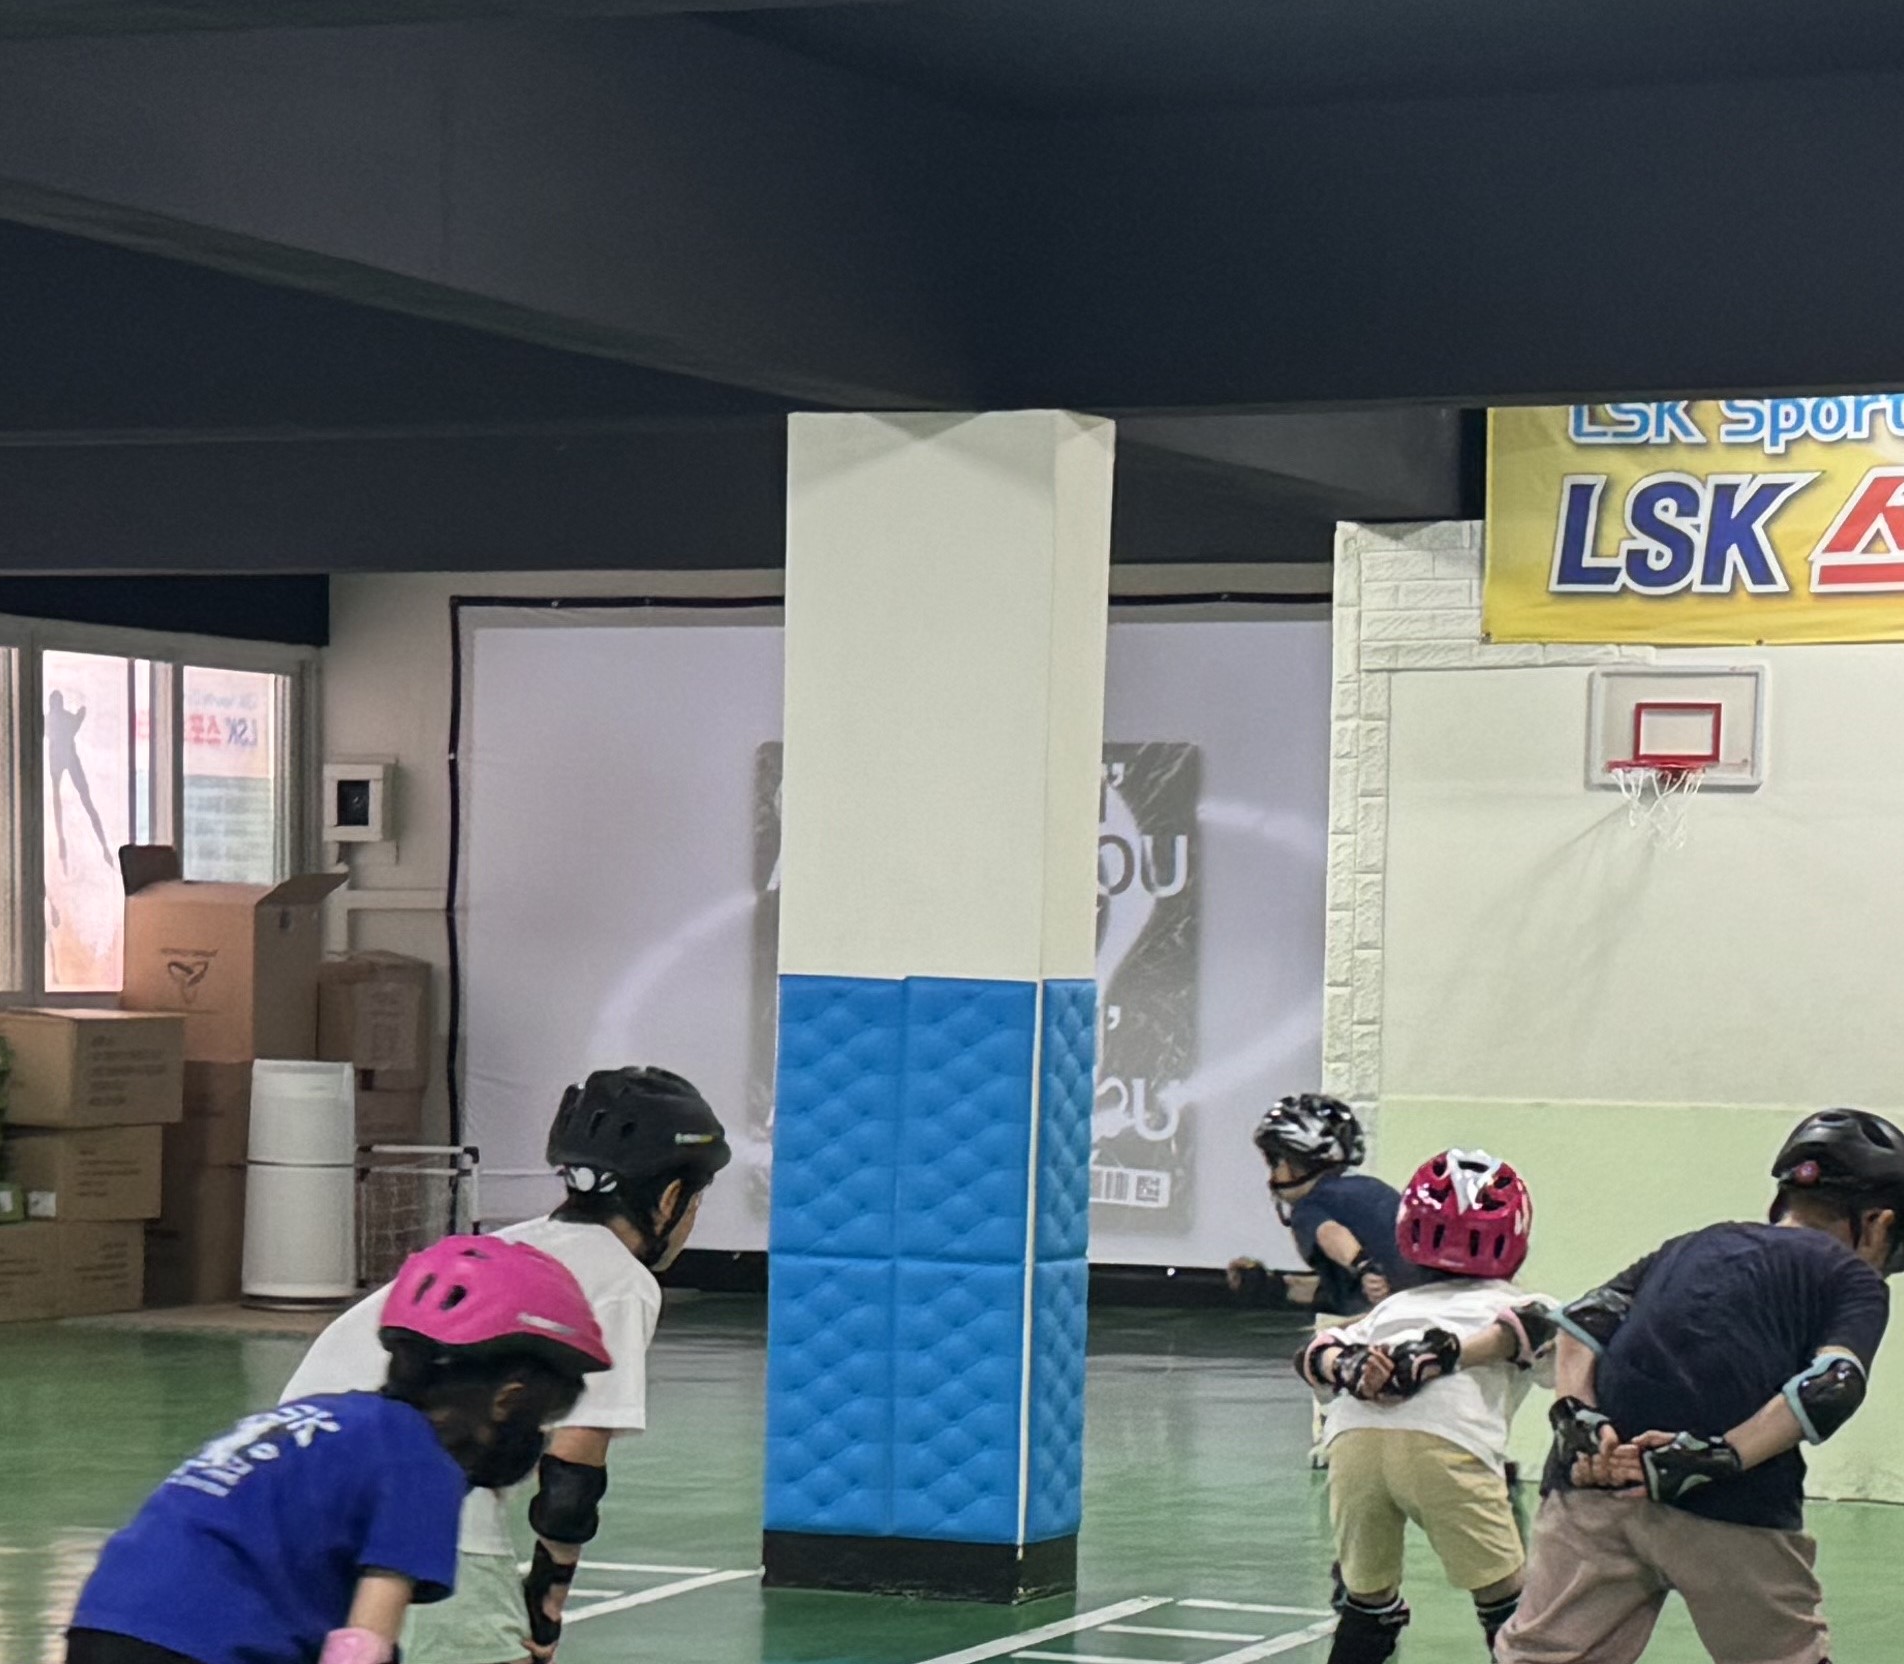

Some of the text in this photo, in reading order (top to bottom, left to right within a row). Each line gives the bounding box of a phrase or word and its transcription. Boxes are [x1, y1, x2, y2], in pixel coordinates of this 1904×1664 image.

[1570, 400, 1702, 442] LSK
[1554, 474, 1808, 588] LSK
[1097, 833, 1188, 897] OU
